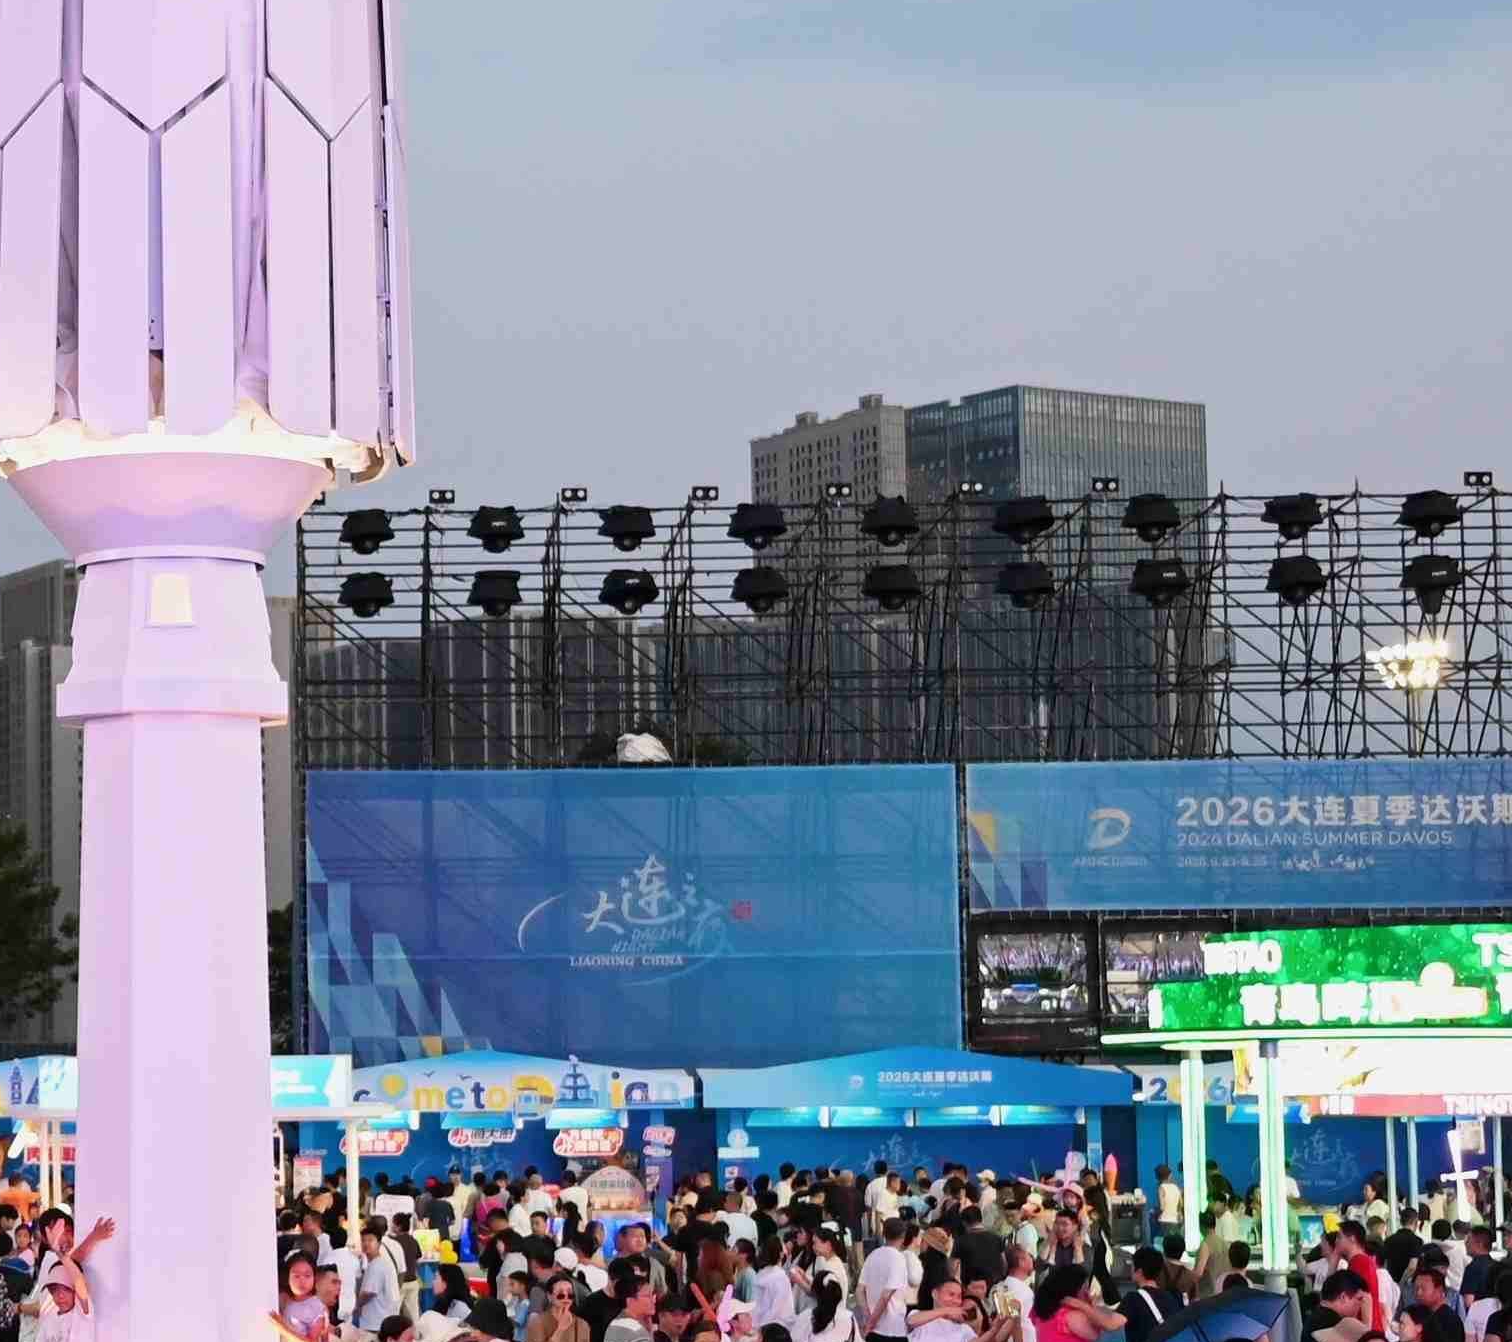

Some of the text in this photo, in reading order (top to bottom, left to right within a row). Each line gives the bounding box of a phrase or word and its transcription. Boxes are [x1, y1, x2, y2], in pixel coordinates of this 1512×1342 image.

[1226, 831, 1297, 846] DALIAN
[1301, 831, 1383, 846] SUMMER
[1388, 830, 1454, 846] DAVOS
[641, 955, 684, 967] CHINA
